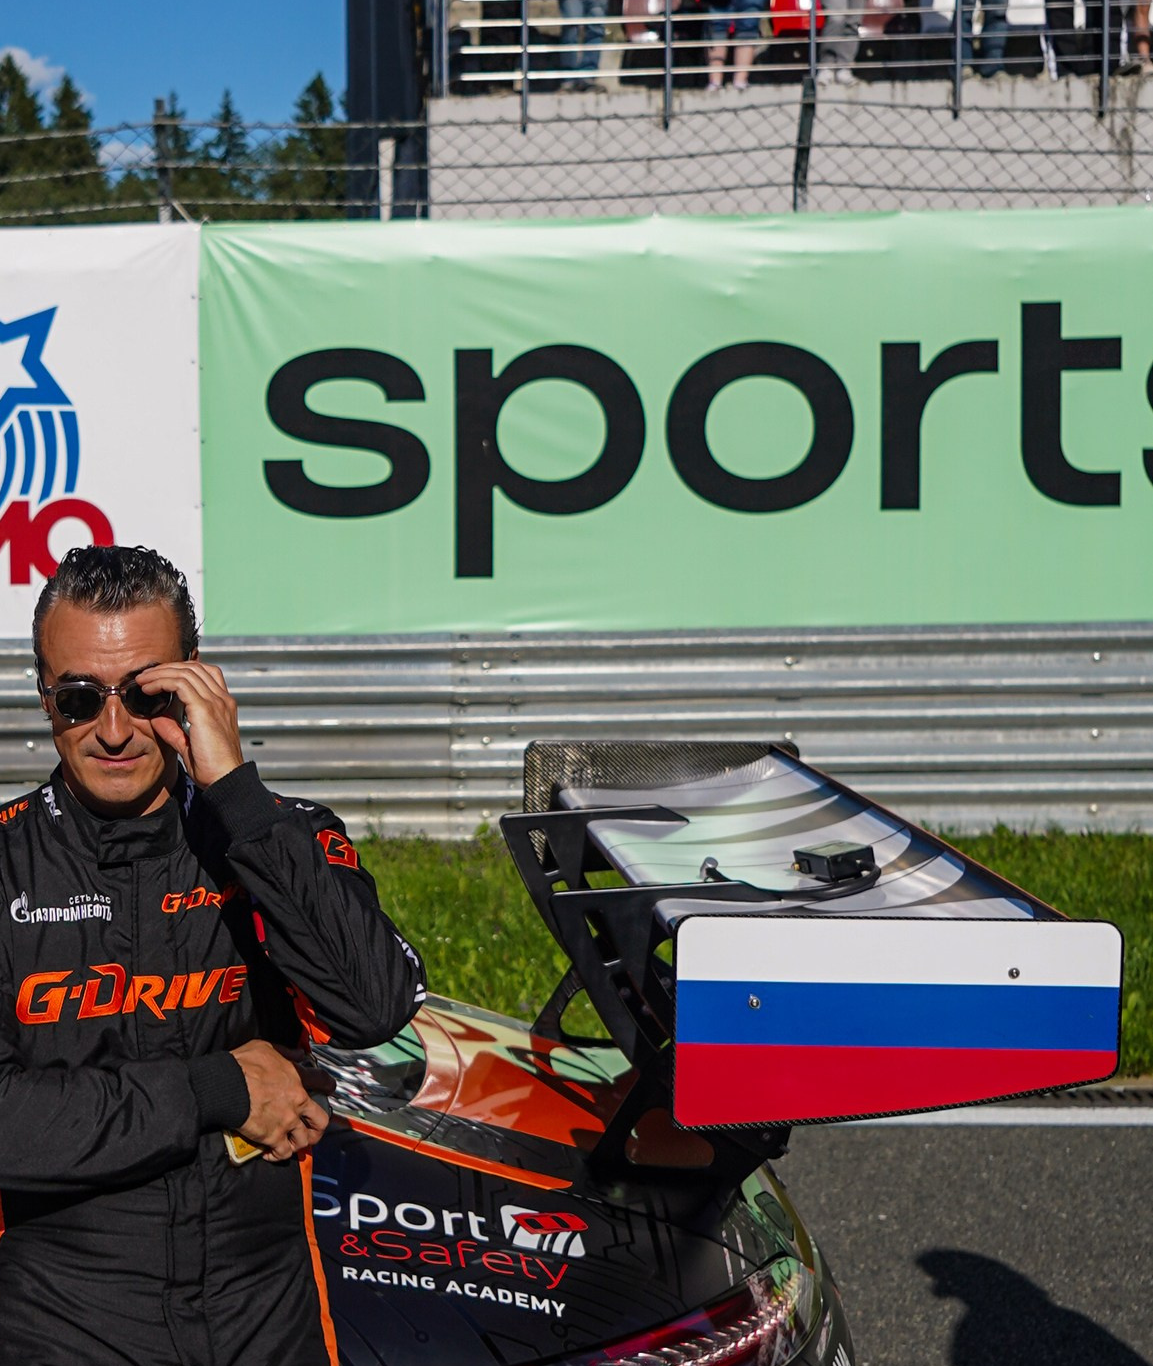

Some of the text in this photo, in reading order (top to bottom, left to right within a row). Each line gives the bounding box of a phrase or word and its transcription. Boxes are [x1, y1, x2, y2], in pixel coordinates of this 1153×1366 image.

[262, 301, 1153, 579] sport
[30, 904, 112, 924] ГАЗПРОМНЕФТЬ
[69, 892, 112, 906] СЕТЬ АЗС
[312, 1174, 490, 1242] Sport
[340, 1230, 569, 1290] &Safety
[342, 1266, 566, 1318] RACING ACADEMY
